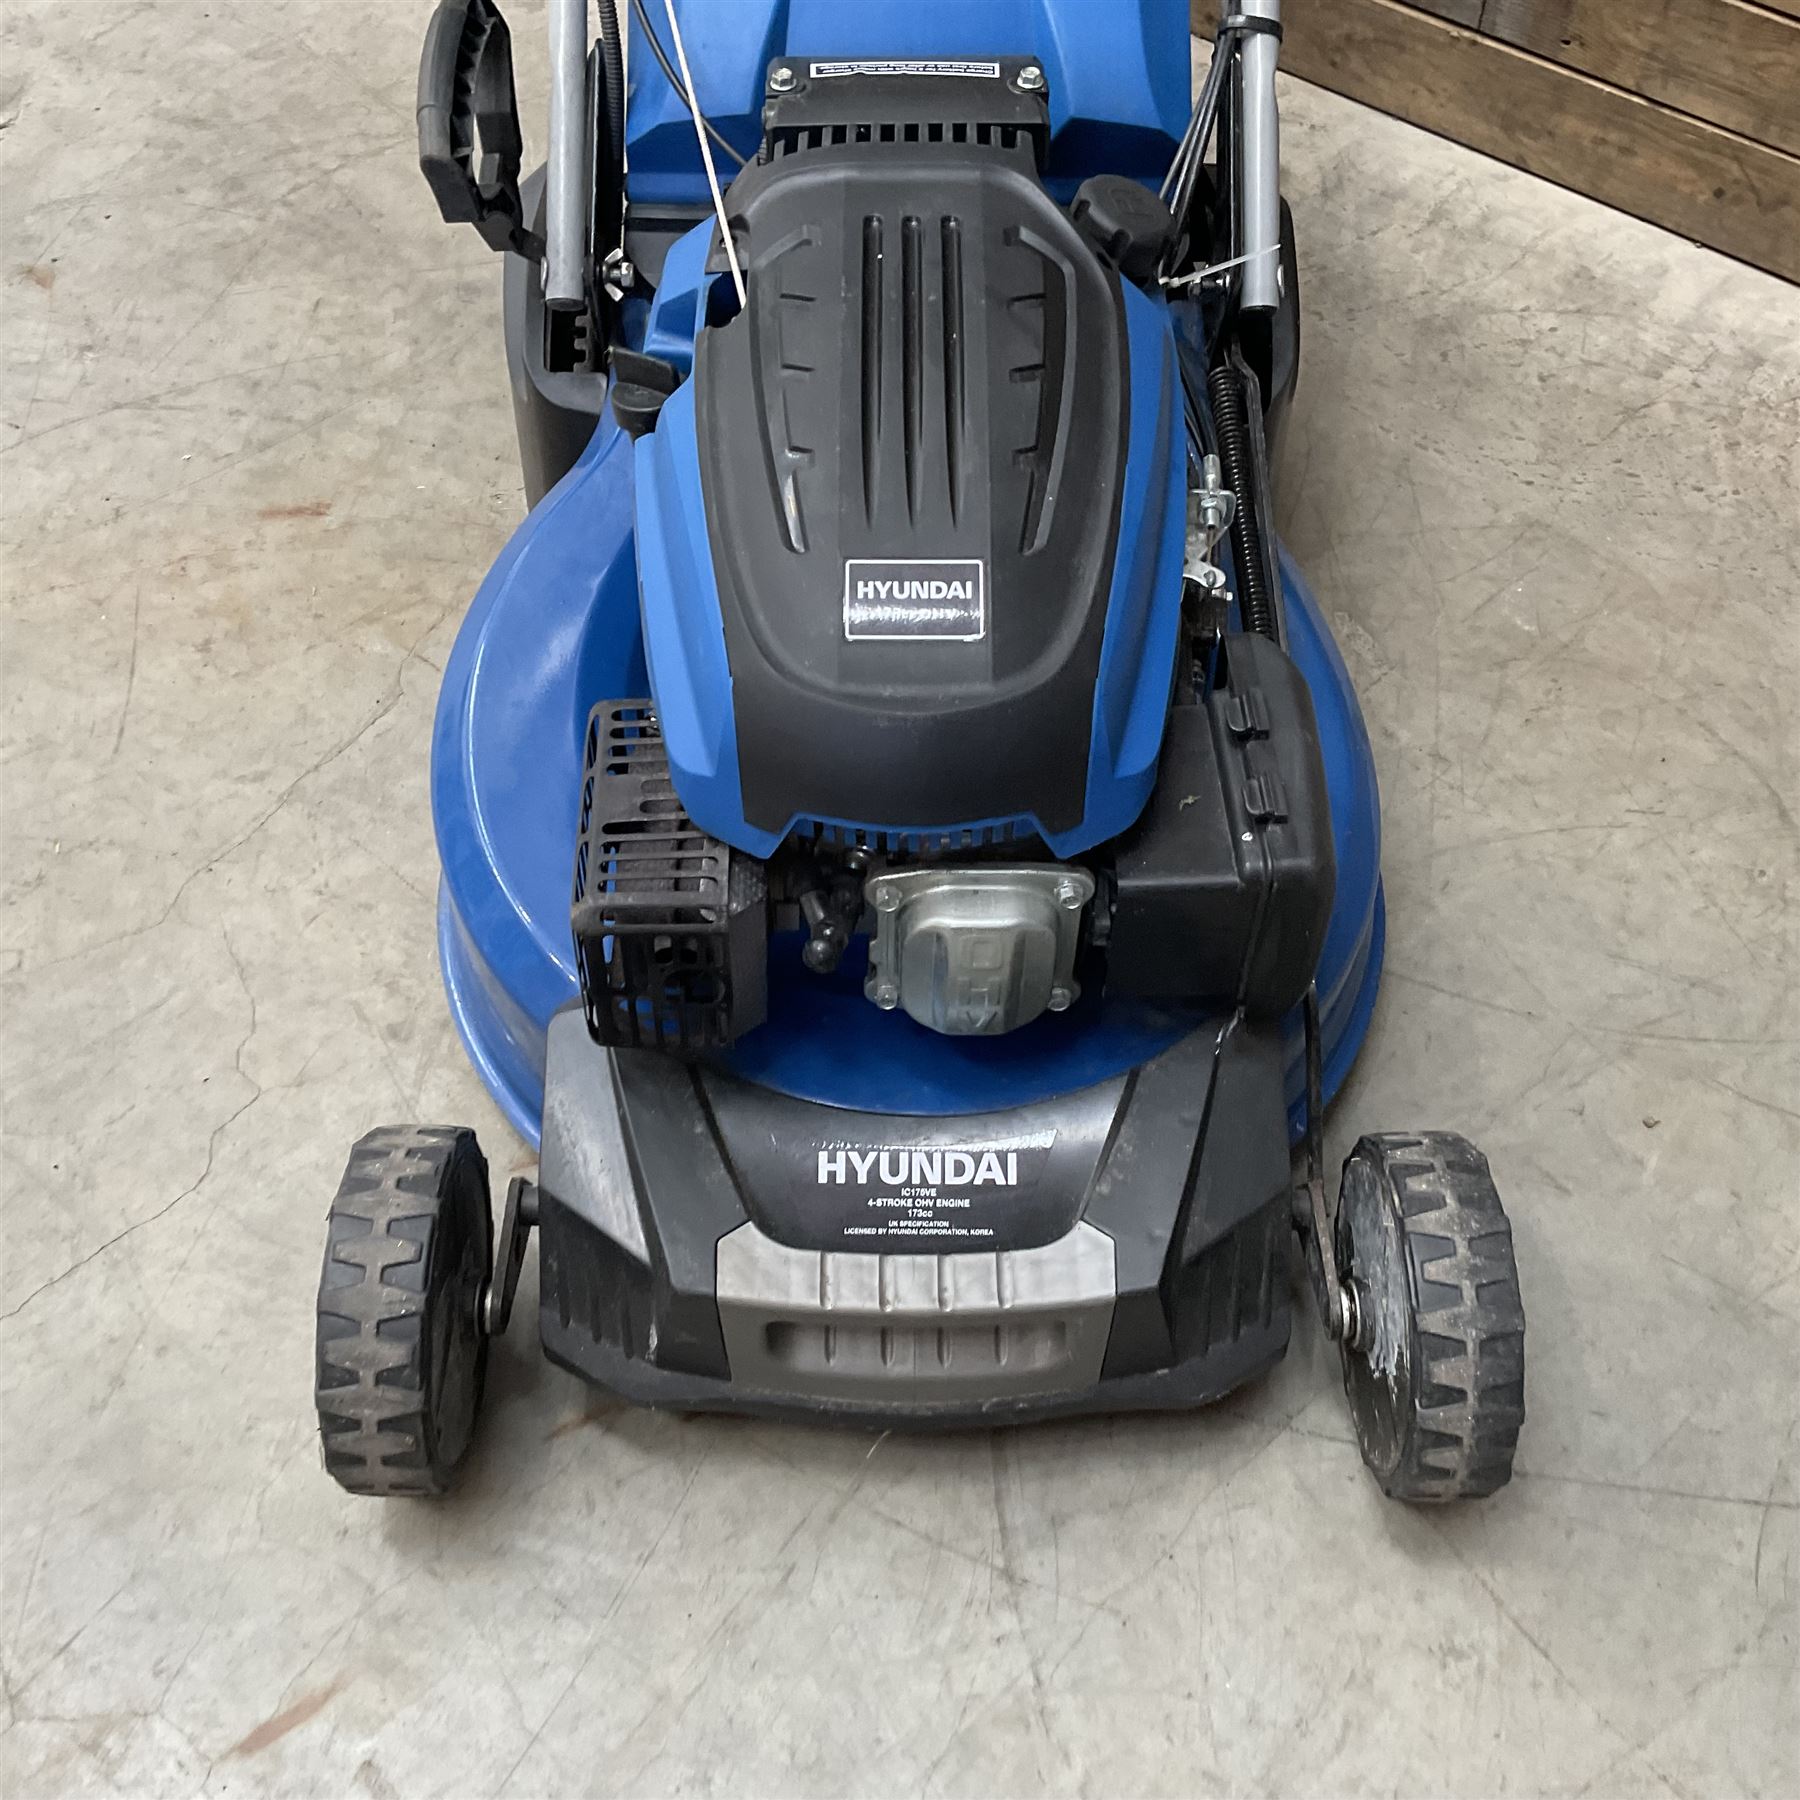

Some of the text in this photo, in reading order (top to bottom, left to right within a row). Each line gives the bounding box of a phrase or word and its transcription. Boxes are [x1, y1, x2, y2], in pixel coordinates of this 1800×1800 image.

[857, 581, 972, 599] HYUNDAI
[817, 1151, 1017, 1186] HYUNDAI
[867, 1198, 971, 1208] 4-STROKE OHV ENGINE
[907, 1208, 933, 1218] 173cc
[888, 1219, 950, 1228] UK SPECIFICATION
[844, 1227, 877, 1235] LICENSED
[878, 1227, 888, 1235] BY
[888, 1228, 918, 1236] HYUNDAI
[970, 1229, 994, 1237] KOREA
